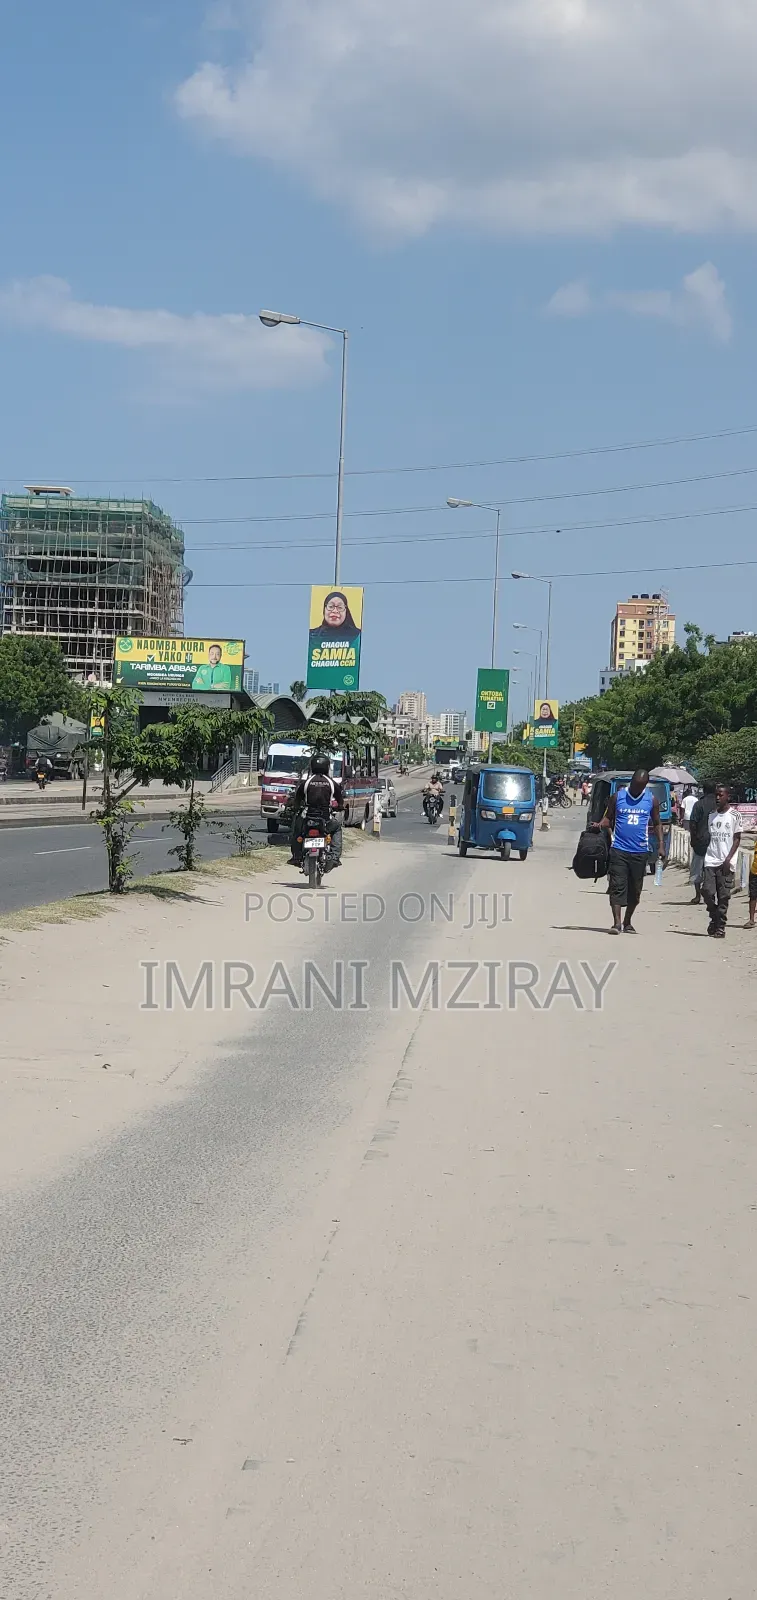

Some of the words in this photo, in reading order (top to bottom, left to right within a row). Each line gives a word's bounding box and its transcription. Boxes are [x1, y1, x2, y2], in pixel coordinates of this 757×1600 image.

[136, 639, 177, 651] NAOMBA
[180, 640, 205, 652] KURA
[158, 651, 182, 662] YAKO
[311, 648, 356, 660] SAMIA
[130, 663, 167, 671] TARIMBA
[168, 664, 197, 673] ABBAS
[627, 814, 639, 825] 25
